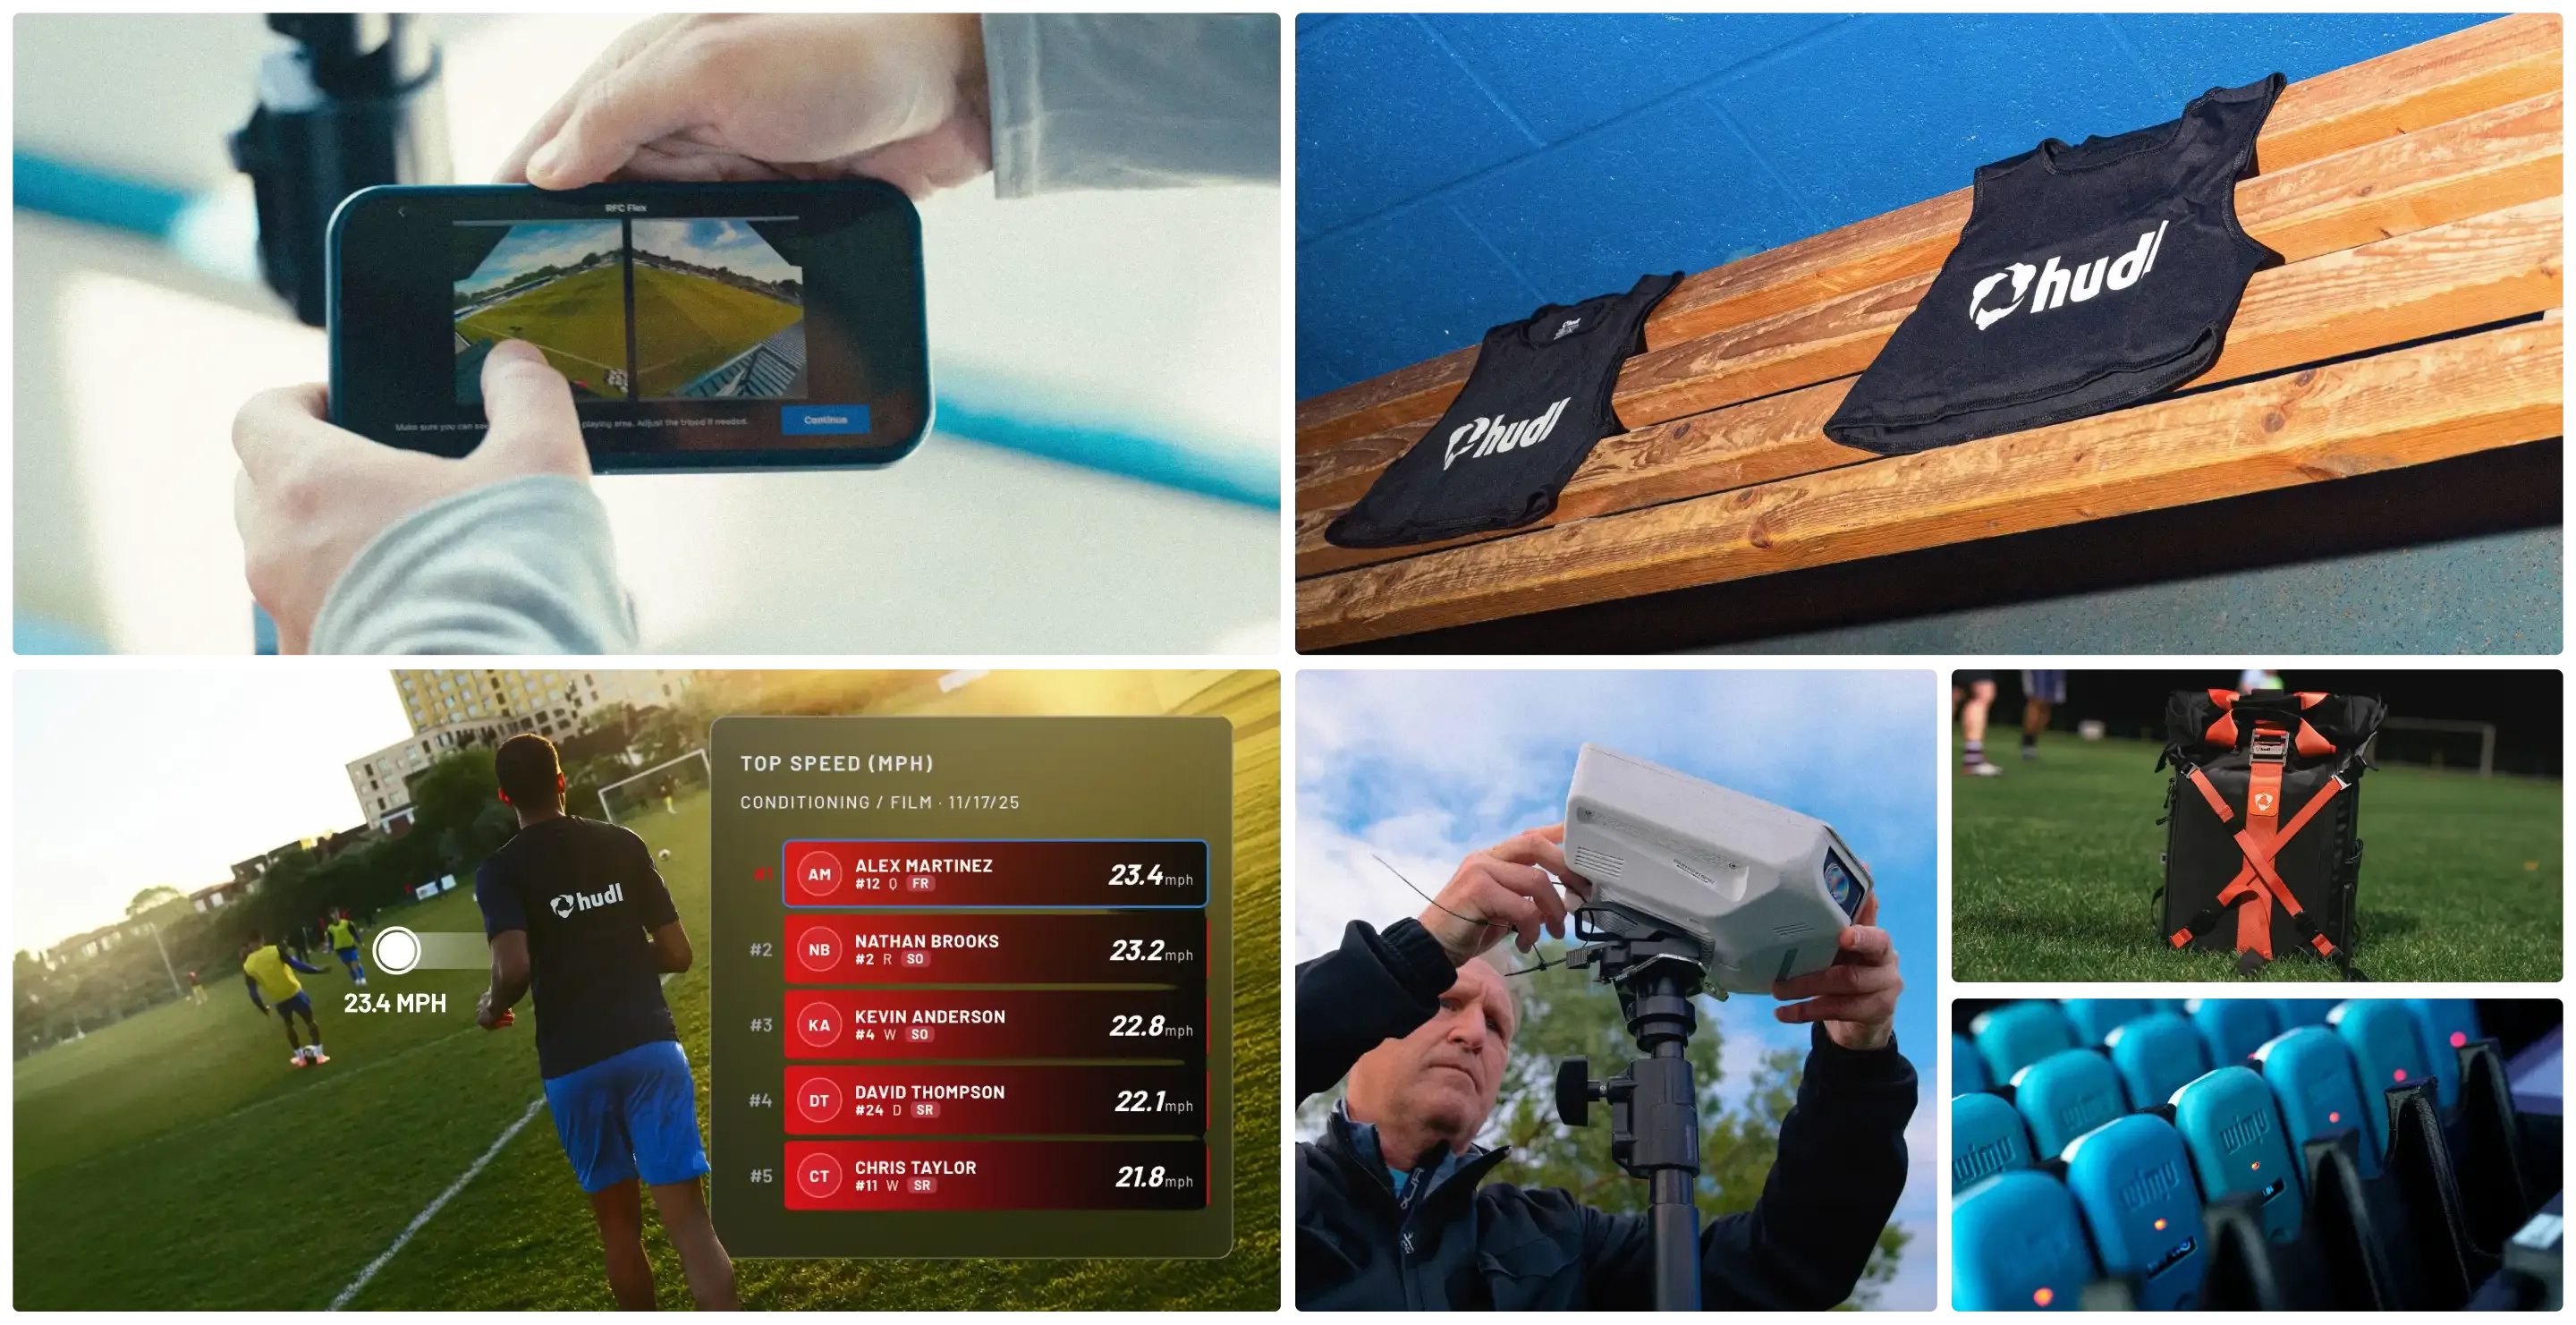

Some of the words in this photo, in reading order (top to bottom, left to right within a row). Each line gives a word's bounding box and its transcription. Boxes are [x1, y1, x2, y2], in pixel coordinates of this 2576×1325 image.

[2029, 220, 2170, 314] hudl
[395, 423, 419, 431] Make
[440, 424, 456, 432] you
[582, 420, 613, 429] playing
[637, 420, 664, 429] Adjust
[680, 419, 706, 428] tripod
[804, 415, 849, 425] Continue
[1472, 396, 1572, 458] hudl
[575, 882, 624, 912] hudl
